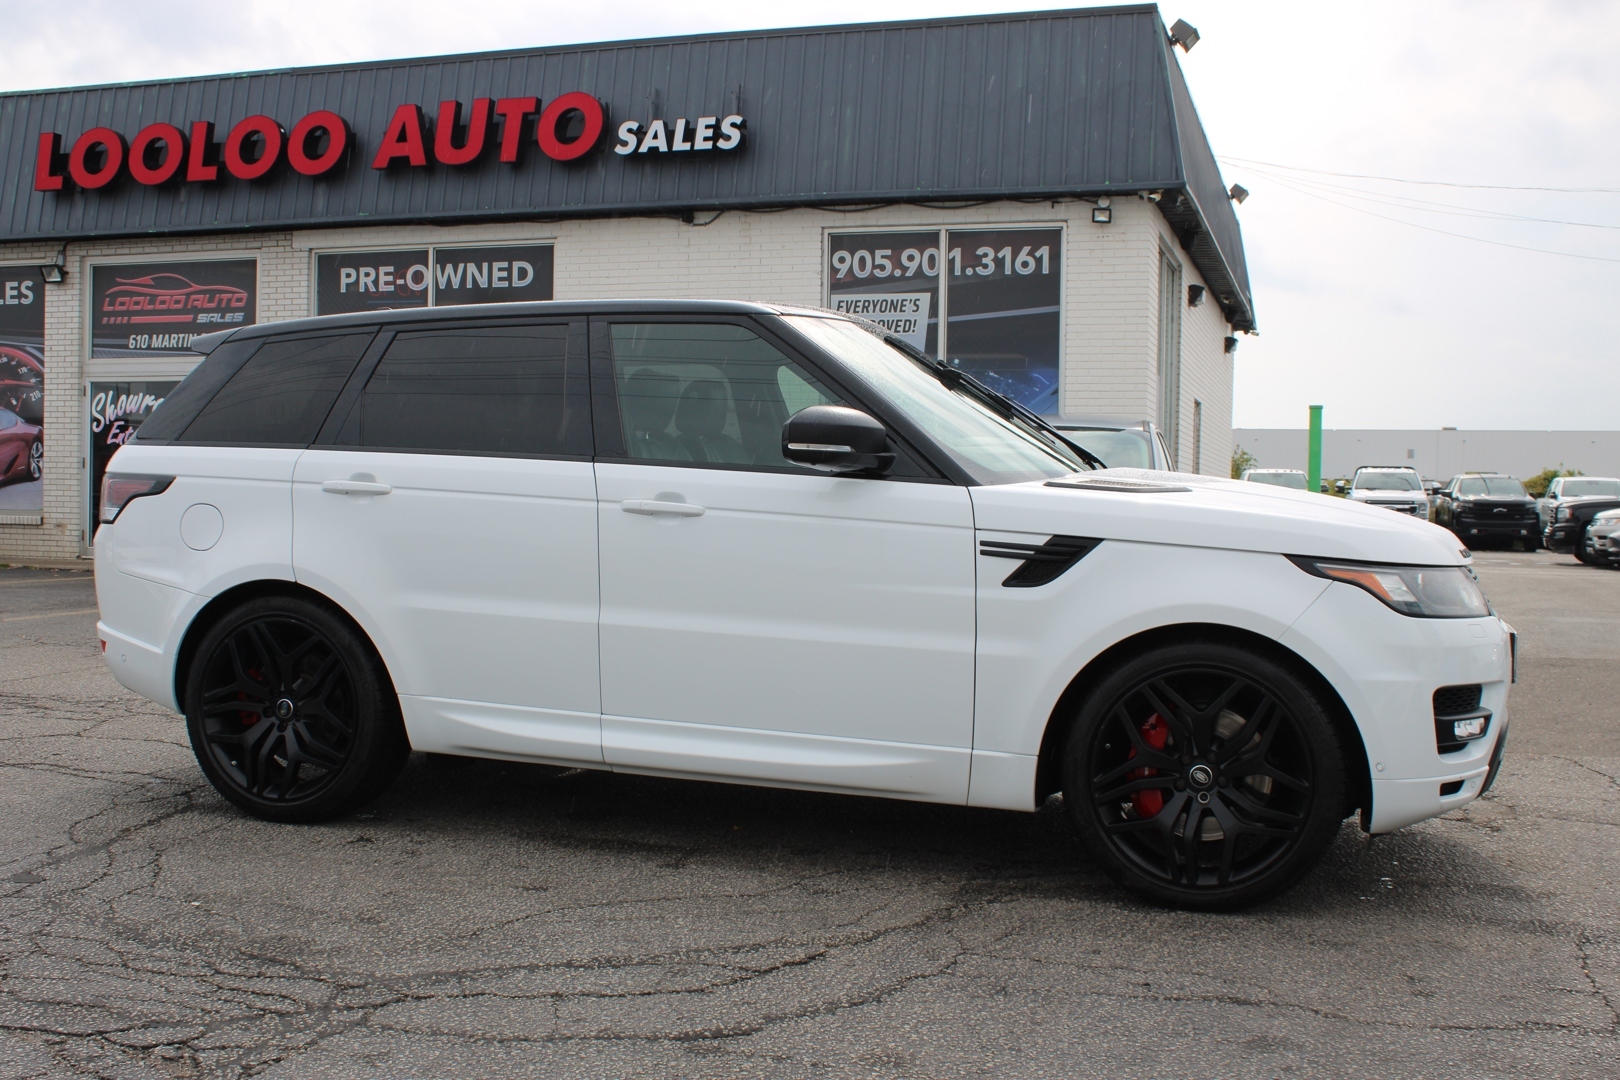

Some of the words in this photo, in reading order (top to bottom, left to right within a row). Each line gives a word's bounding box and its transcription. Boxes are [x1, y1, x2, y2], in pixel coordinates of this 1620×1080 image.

[34, 110, 347, 191] LOOLOO
[371, 91, 604, 170] AUTO
[614, 114, 744, 156] SALES
[831, 245, 1050, 279] 905.901.3161
[340, 260, 534, 293] PRE-OWNED
[102, 295, 186, 312] LOOLOO
[187, 293, 248, 309] AUTO
[836, 298, 921, 314] EVERYONE'S
[196, 312, 245, 324] SALES
[128, 334, 149, 349] 610
